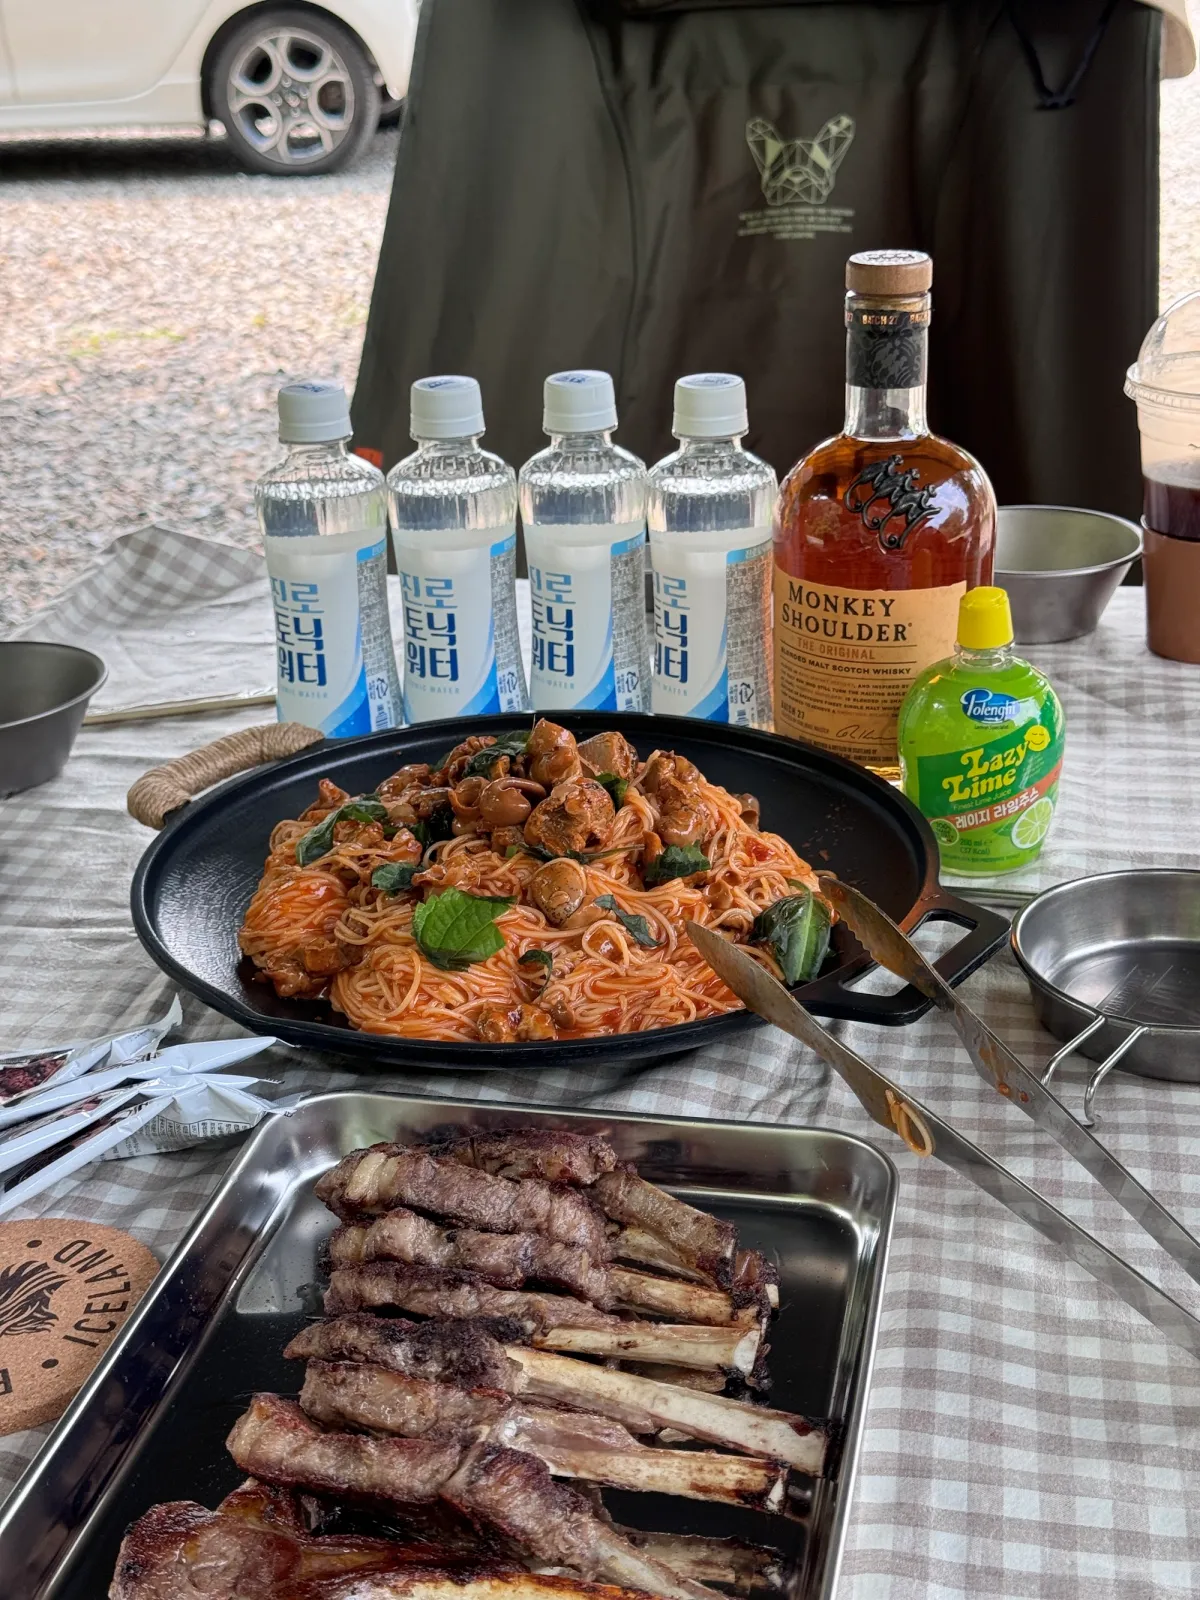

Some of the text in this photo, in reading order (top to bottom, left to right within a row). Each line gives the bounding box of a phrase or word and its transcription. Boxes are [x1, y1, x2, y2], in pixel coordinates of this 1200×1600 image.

[862, 314, 898, 325] BATCH 27
[270, 577, 324, 613] 진로
[400, 570, 458, 608] 진로
[788, 580, 895, 617] MONKEY
[276, 612, 324, 651] 토닉
[406, 606, 457, 646] 토닉
[782, 603, 907, 642] SHOULDER
[279, 646, 327, 687] 워터
[407, 641, 459, 682] 워터
[797, 637, 876, 660] THE ORIGINAL
[808, 659, 830, 670] MALT
[832, 664, 870, 674] SCOTCH
[872, 667, 911, 675] WHISKY
[817, 684, 831, 692] STILL
[960, 740, 1030, 778] Lazy
[942, 767, 1017, 802] Lime
[955, 786, 1040, 829] 레이지 라임주스
[53, 1239, 131, 1348] ICELAND
